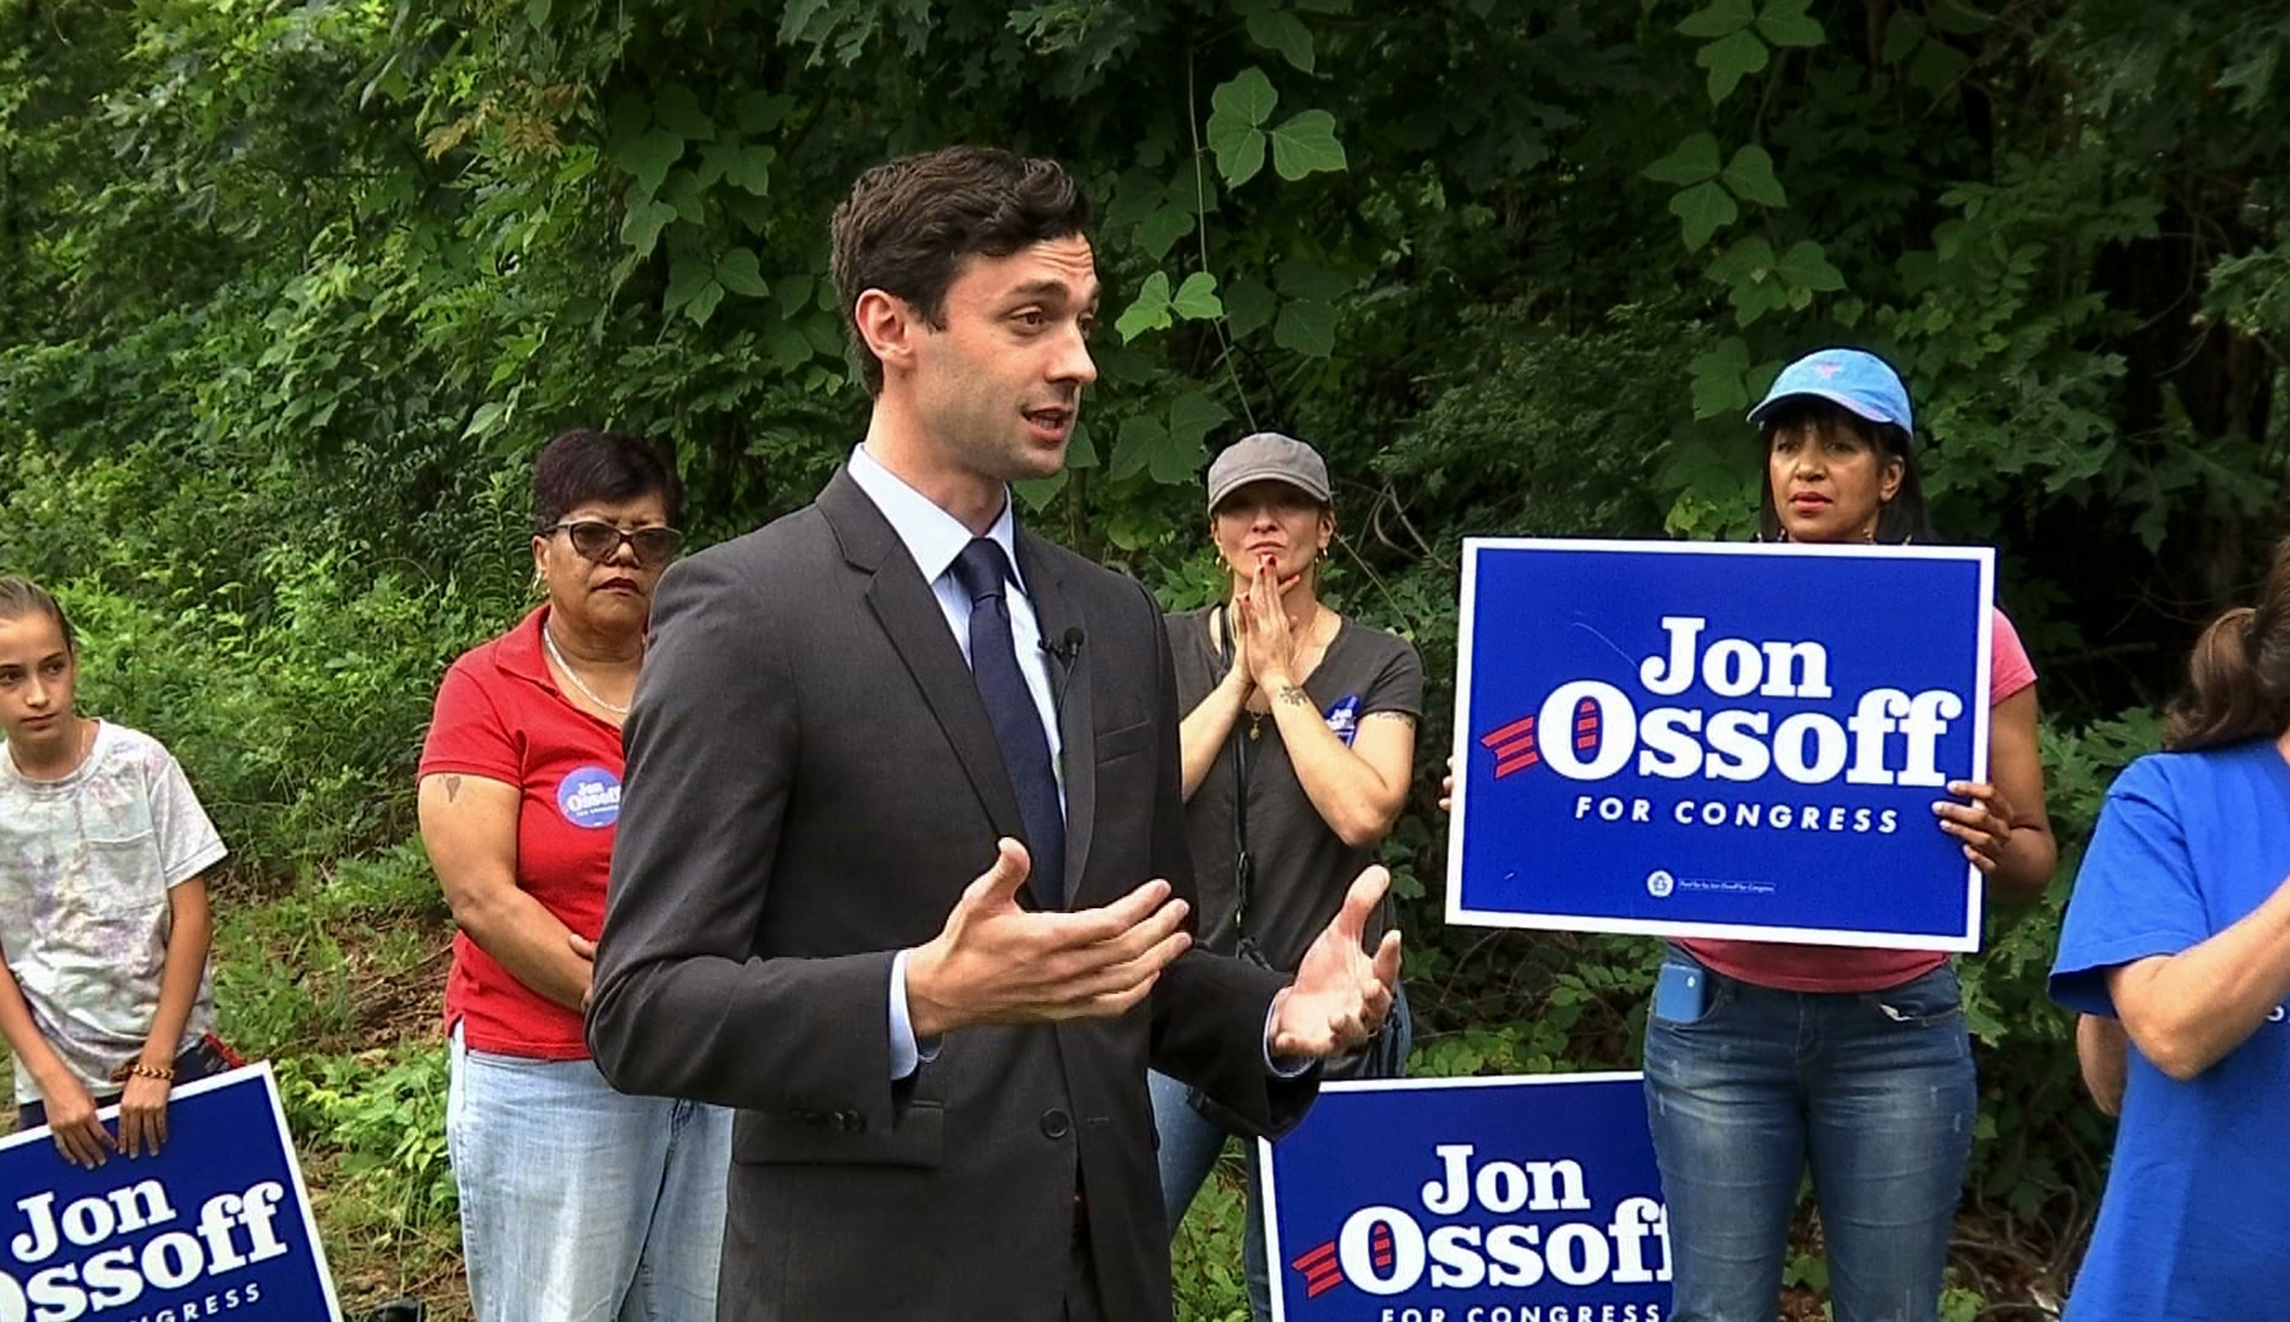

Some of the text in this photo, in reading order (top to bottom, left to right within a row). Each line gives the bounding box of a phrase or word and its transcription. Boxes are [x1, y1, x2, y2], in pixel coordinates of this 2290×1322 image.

[1640, 616, 1832, 697] Jon
[1537, 680, 1963, 787] Ossoff
[1575, 796, 1897, 833] FOR CONGRESS
[1422, 1144, 1591, 1214] Jon
[11, 1180, 177, 1262] Jon
[129, 1283, 260, 1322] GRESS
[1382, 1304, 1661, 1322] FOR CONGRESS
